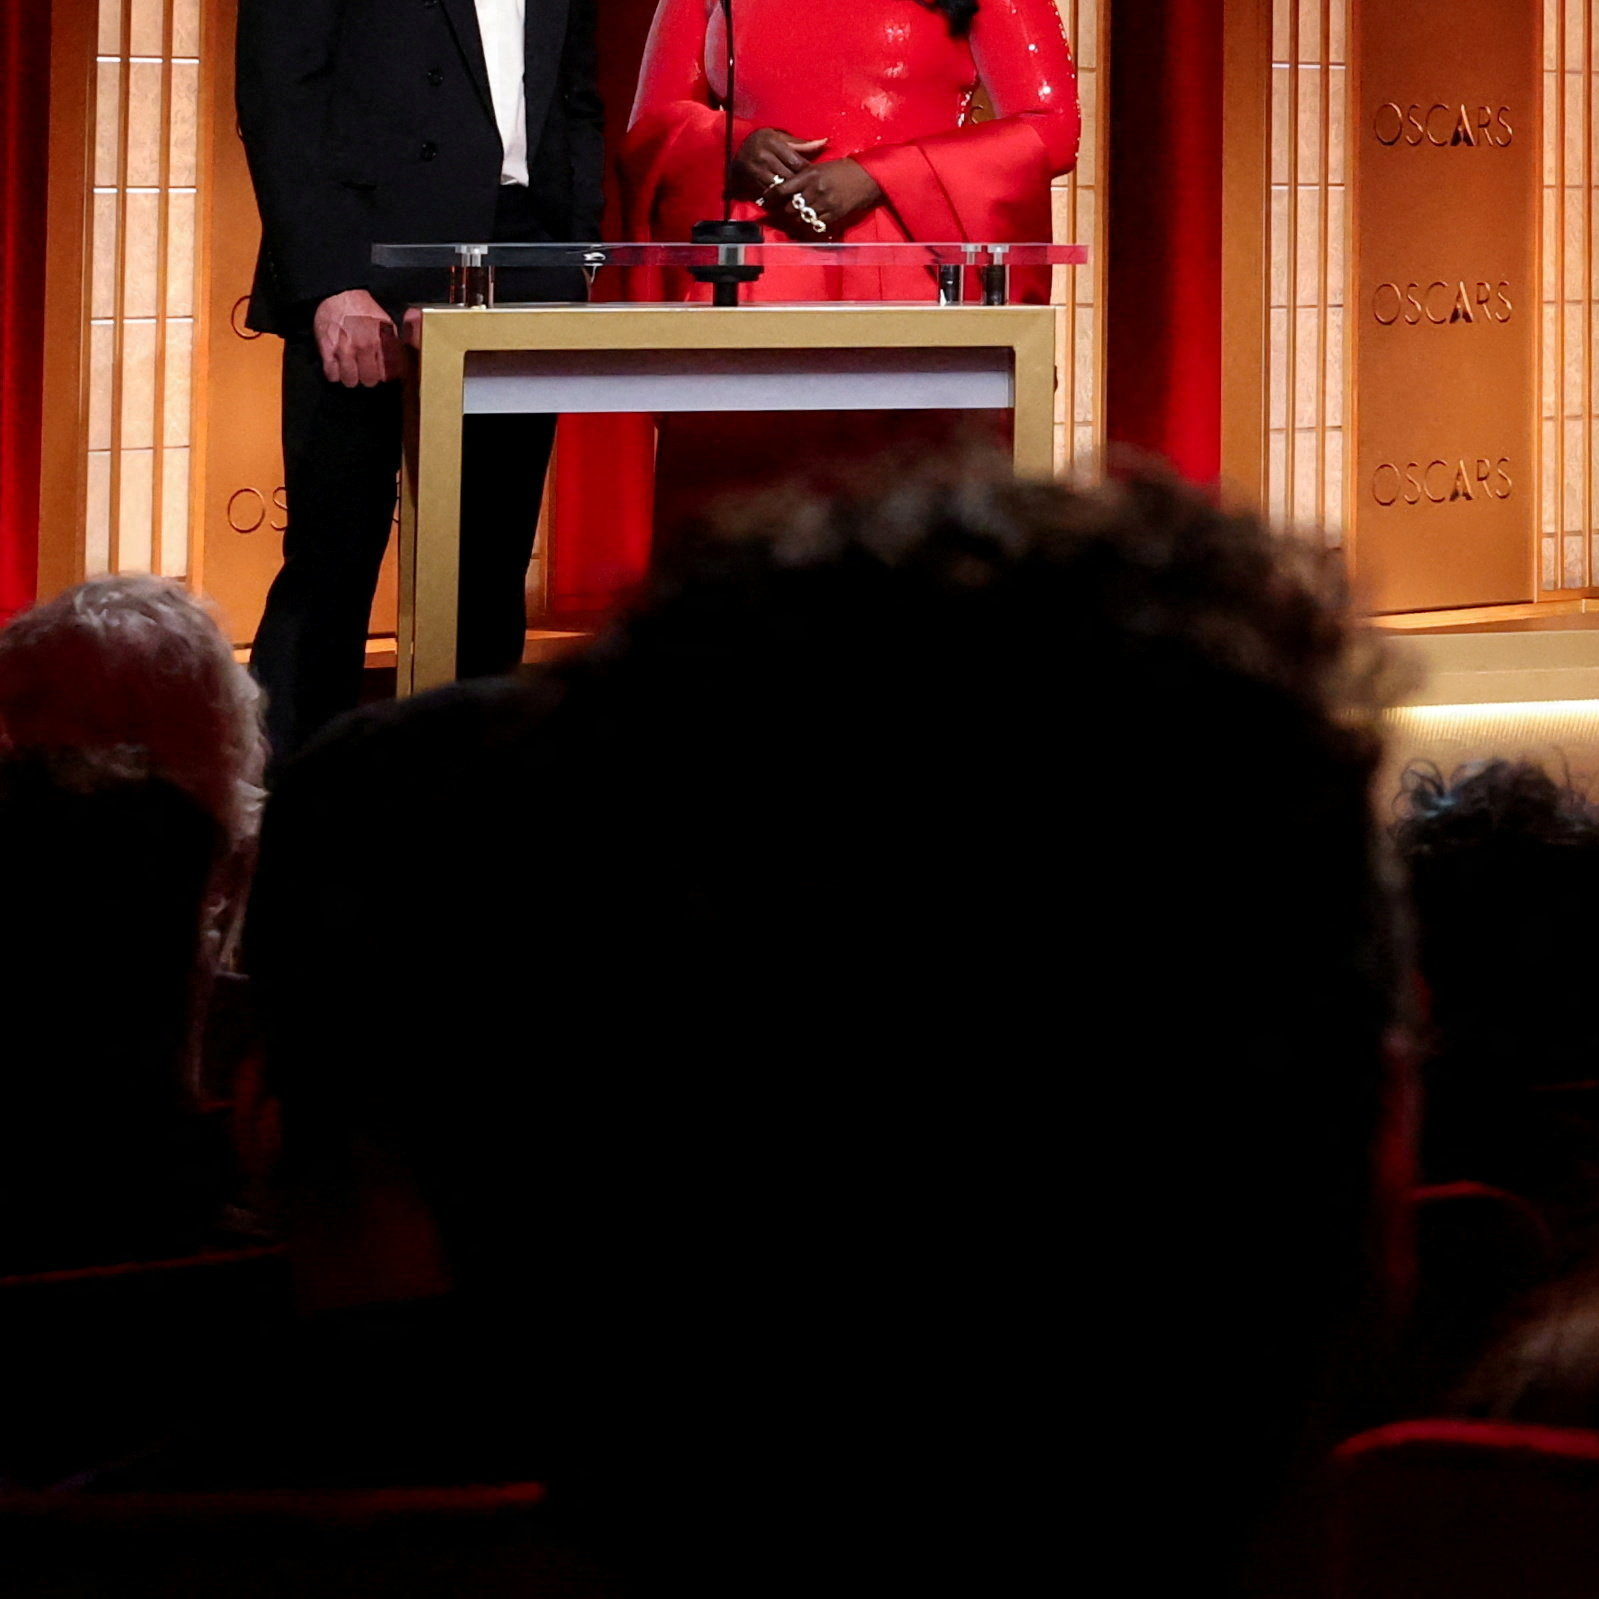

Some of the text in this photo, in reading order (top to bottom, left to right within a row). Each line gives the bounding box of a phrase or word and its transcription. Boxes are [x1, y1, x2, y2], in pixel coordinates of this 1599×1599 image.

[1373, 101, 1513, 148] OSCARS
[1372, 280, 1513, 326] OSCARS
[1371, 457, 1513, 507] OSCARS
